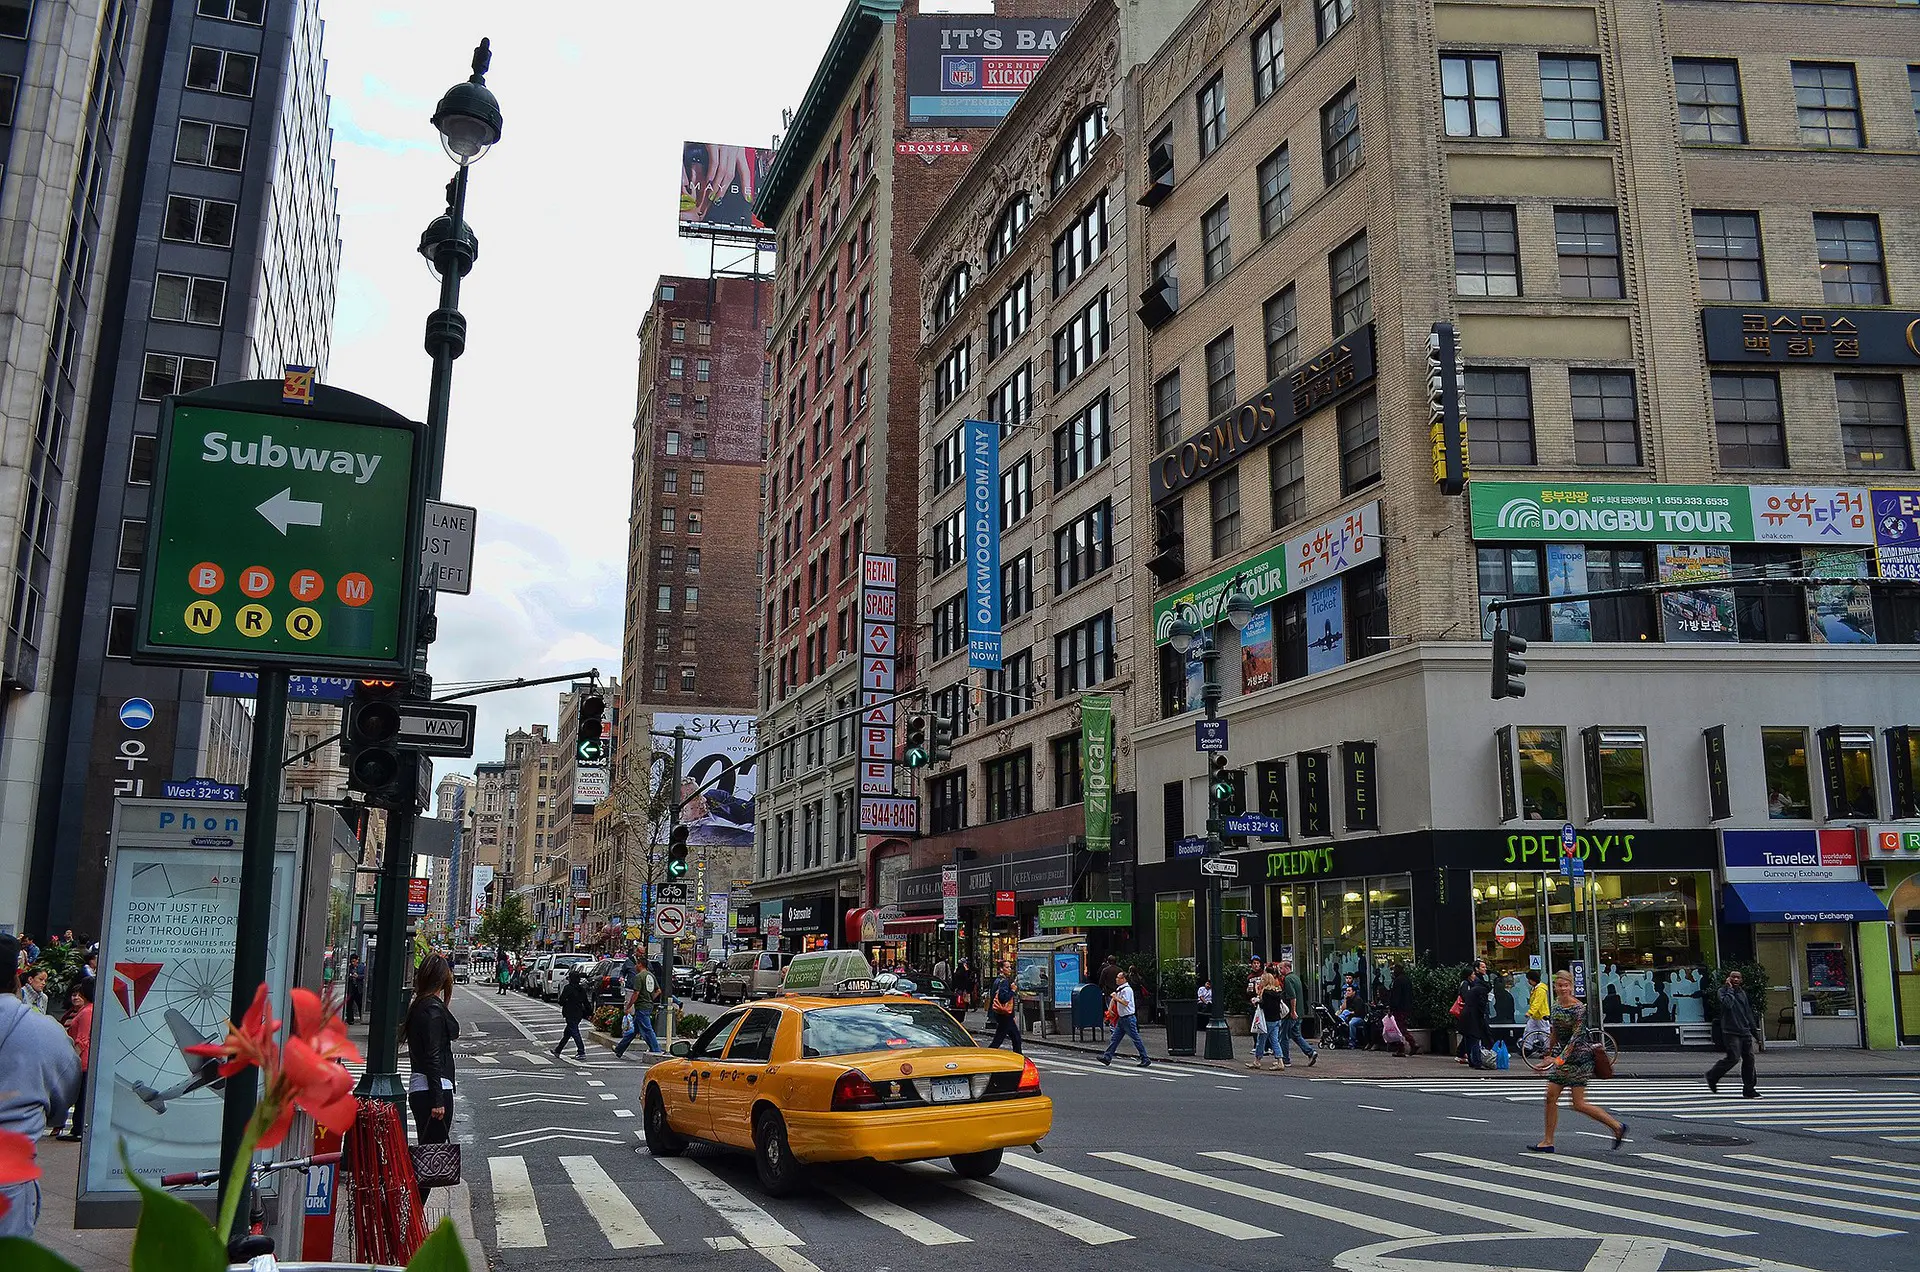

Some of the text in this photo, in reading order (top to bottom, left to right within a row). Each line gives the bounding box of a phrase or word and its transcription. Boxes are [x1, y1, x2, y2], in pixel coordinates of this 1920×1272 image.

[941, 28, 1003, 49] IT'S
[899, 144, 969, 152] TROYSTAR
[1742, 315, 1858, 334] 코스모스
[1744, 336, 1860, 357] 백화점
[1162, 391, 1276, 490] COSMOS
[202, 431, 382, 484] Subway
[1761, 491, 1866, 536] 유학닷컴
[1899, 495, 1920, 516] E-
[432, 513, 467, 531] LANE
[975, 428, 992, 625] OAKWOOD.COM/NY
[1542, 508, 1734, 533] DONGBU TOUR
[421, 536, 451, 555] UST
[1298, 512, 1363, 575] 유학닷컴
[1761, 532, 1793, 540] uhak.com
[1551, 552, 1583, 562] Europe
[440, 566, 463, 581] EFT
[866, 560, 895, 583] RETAIL
[199, 568, 366, 600] B D F M
[1311, 584, 1338, 602] Airline
[866, 593, 893, 617] SPACE
[1312, 598, 1337, 615] Ticket
[192, 608, 314, 637] N R Q
[1678, 620, 1723, 632] 가방보관
[971, 641, 999, 651] RENT
[971, 652, 999, 662] NOW!
[868, 626, 889, 778] AVAILABLE
[425, 719, 460, 735] WAY
[1085, 730, 1110, 813] zipcar
[1712, 738, 1722, 796] EAT
[1826, 738, 1840, 809] MEET
[167, 786, 234, 800] West 32nd St
[862, 782, 891, 793] CALL
[1268, 771, 1279, 818] EAT
[1307, 757, 1320, 831] DRINK
[1353, 751, 1367, 821] MEET
[871, 803, 915, 828] 944-8416
[1228, 772, 1237, 847] NATUL
[159, 811, 239, 832] Phon
[1228, 820, 1279, 832] West 32nd St
[1266, 847, 1334, 878] SPEEDY'S
[1763, 852, 1817, 865] Travelex
[1763, 870, 1833, 879] Currency Exchange
[129, 901, 220, 913] DON'T JUST FLY
[1050, 909, 1066, 923] zipcar
[1784, 912, 1854, 922] Currency Exchange
[127, 913, 161, 924] FROM
[165, 915, 188, 924] THE
[126, 925, 225, 937] FLY THROUGH IT.
[847, 980, 870, 991] 4M50
